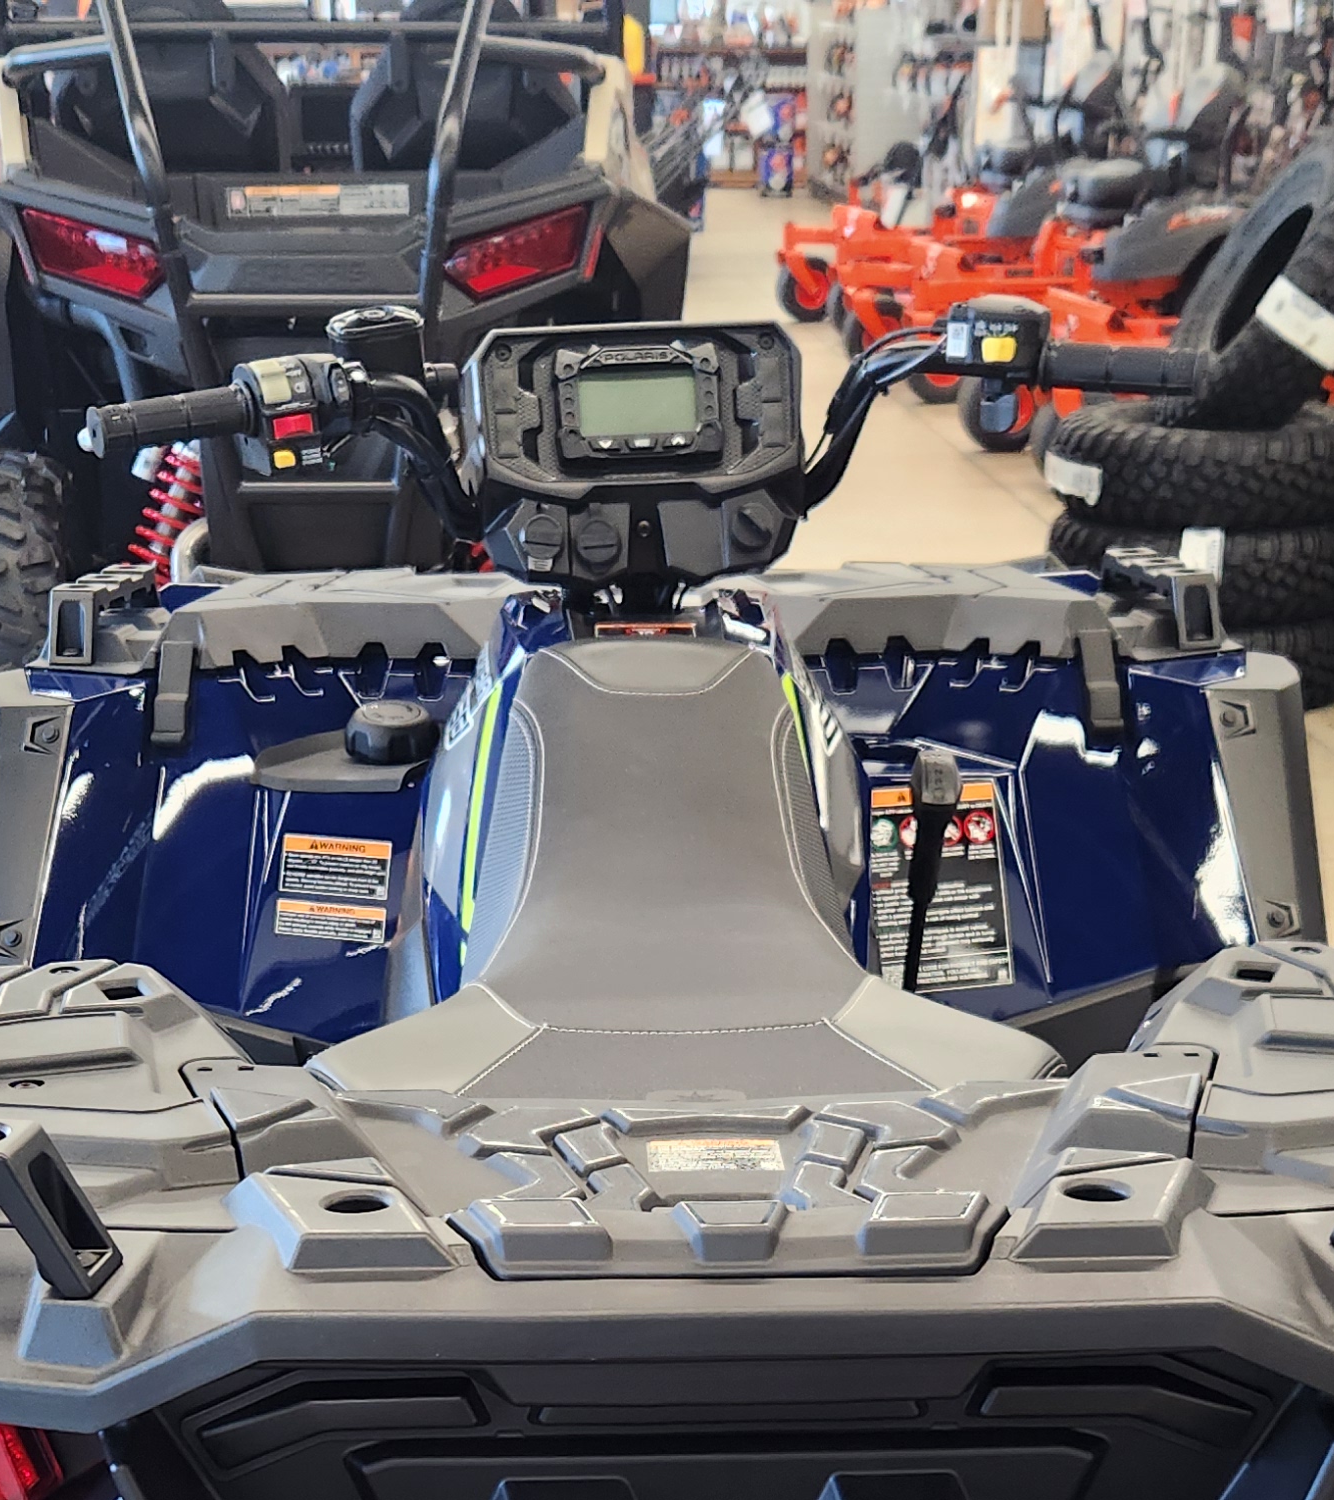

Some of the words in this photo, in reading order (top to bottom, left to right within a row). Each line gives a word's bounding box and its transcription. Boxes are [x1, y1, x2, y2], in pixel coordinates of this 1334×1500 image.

[604, 351, 669, 362] POLARIS
[319, 841, 366, 853] WARNING
[316, 906, 355, 915] WARNING
